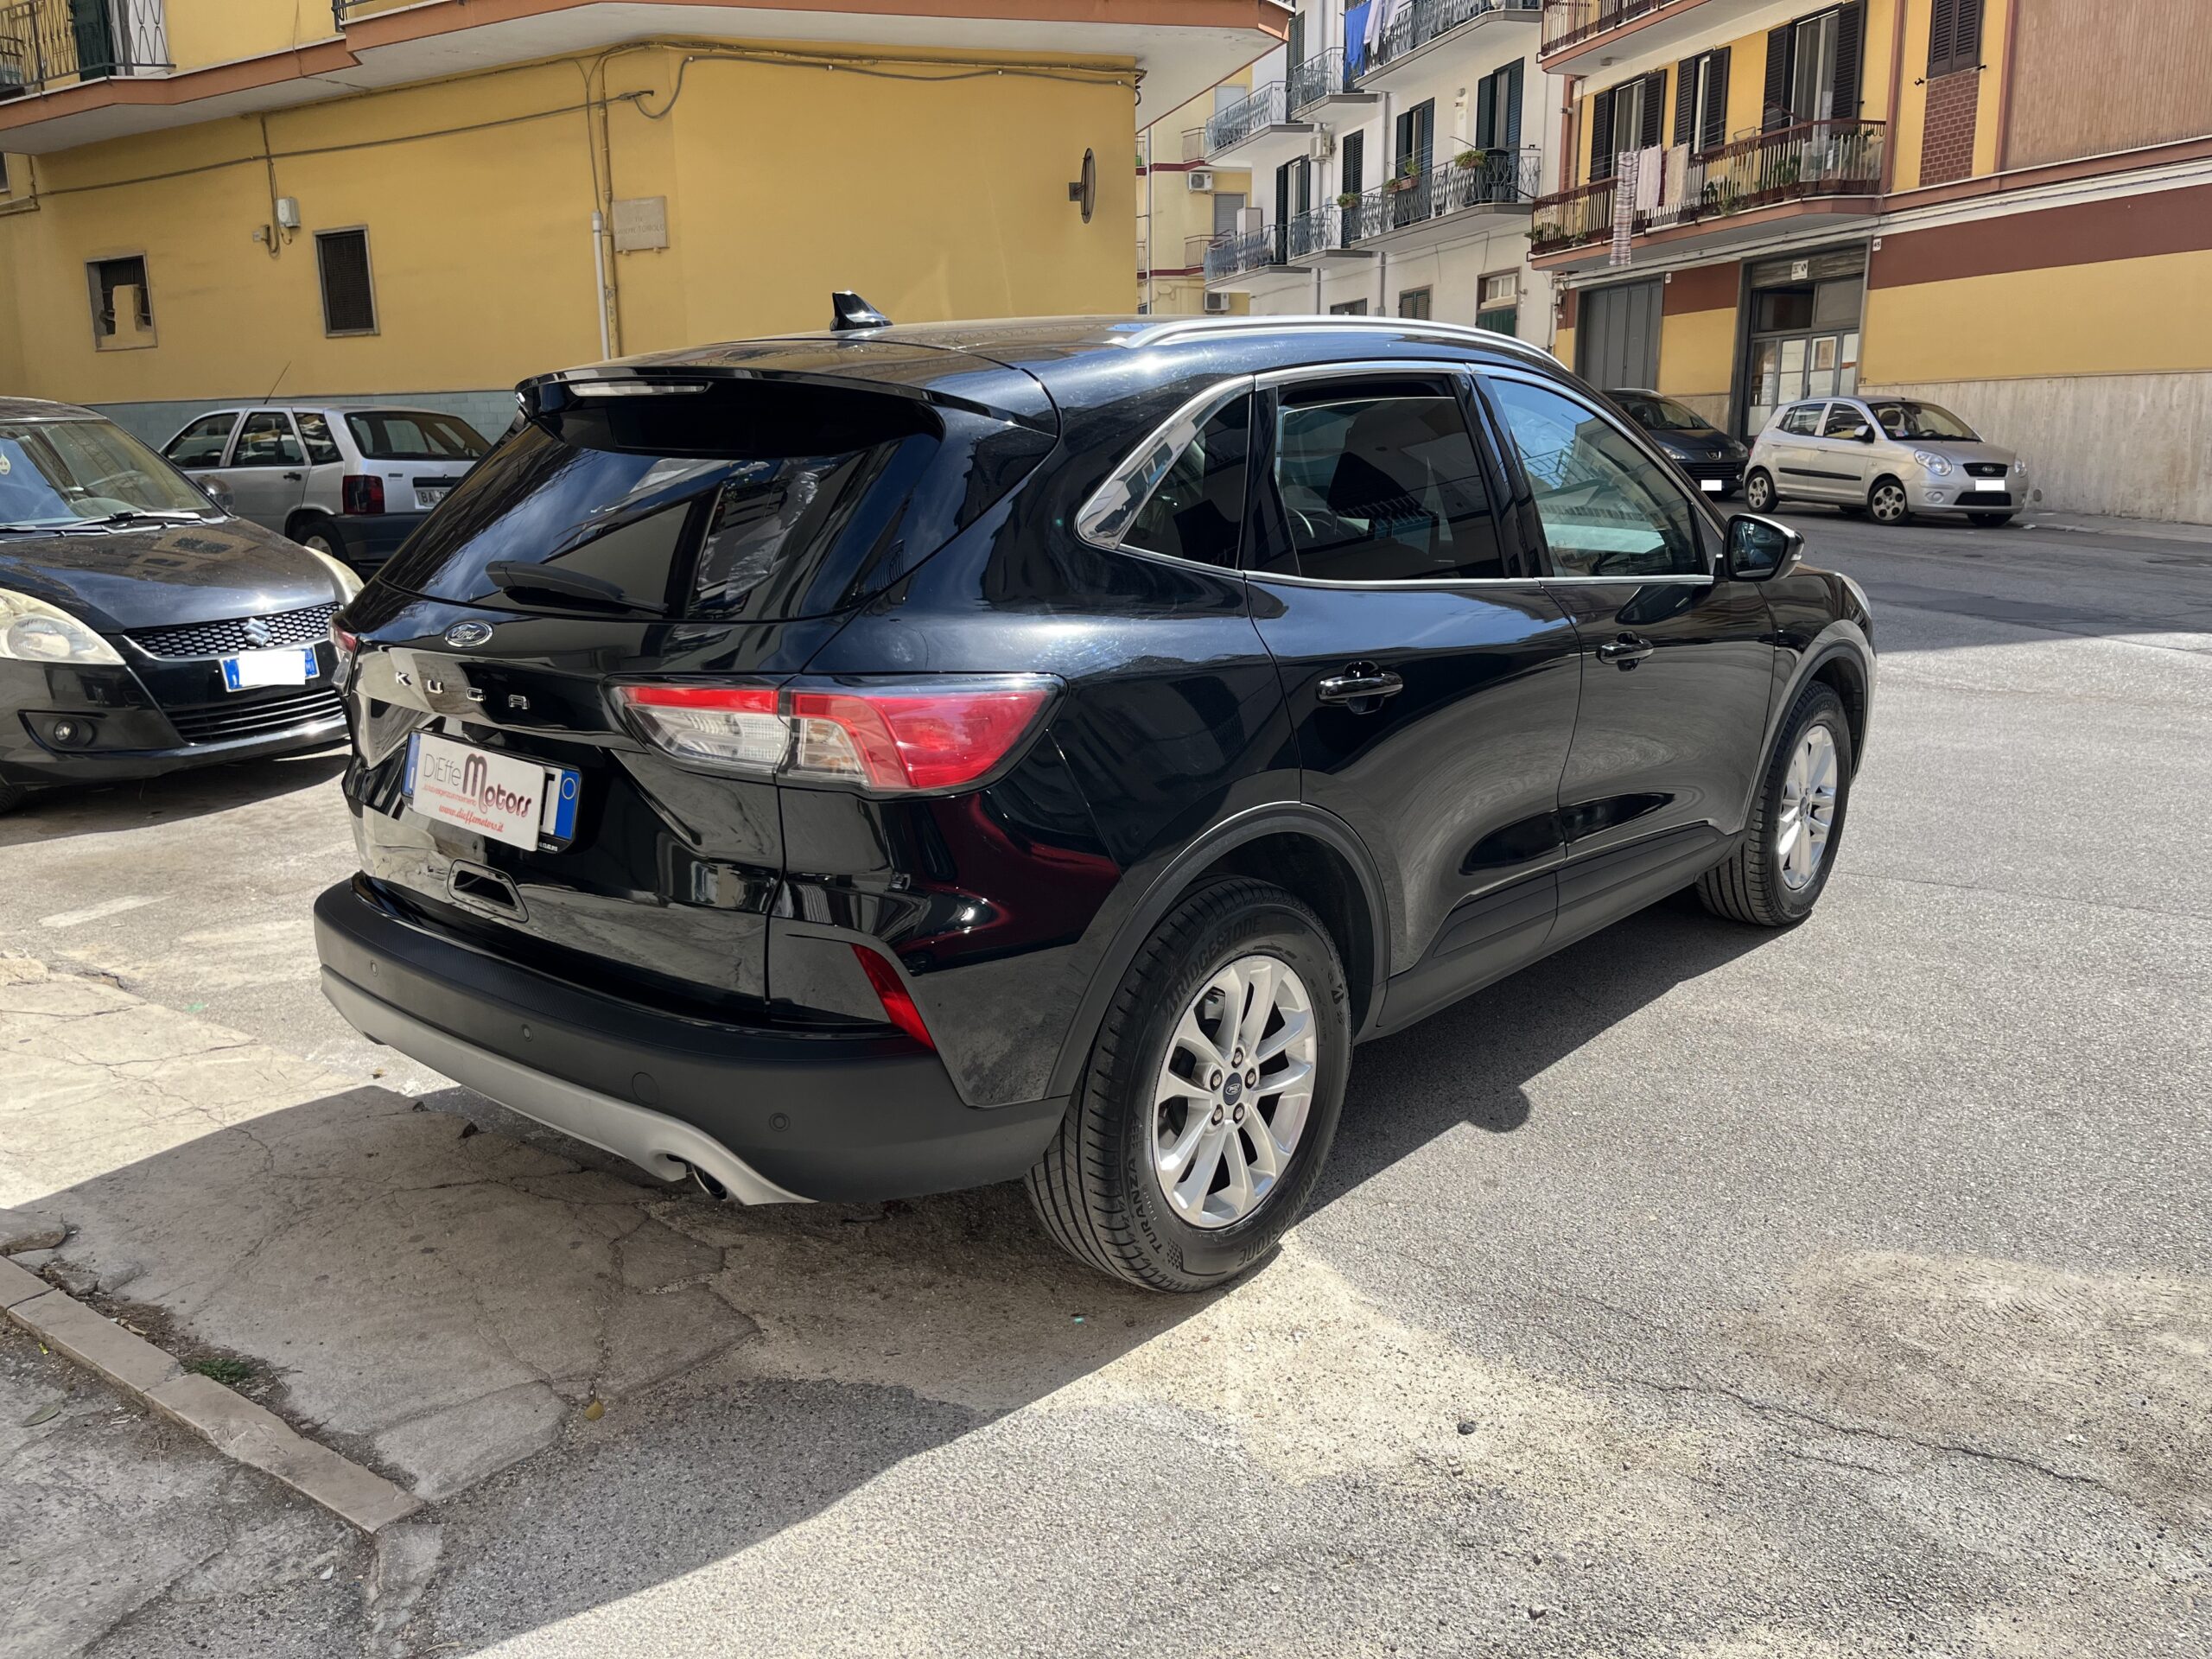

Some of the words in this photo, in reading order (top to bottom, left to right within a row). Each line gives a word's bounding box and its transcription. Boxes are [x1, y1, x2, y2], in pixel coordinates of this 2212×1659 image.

[421, 492, 435, 503] BA
[451, 624, 482, 641] Ford
[395, 671, 531, 710] KUGA
[462, 753, 532, 818] Motors
[1128, 1158, 1163, 1255] TURANZA
